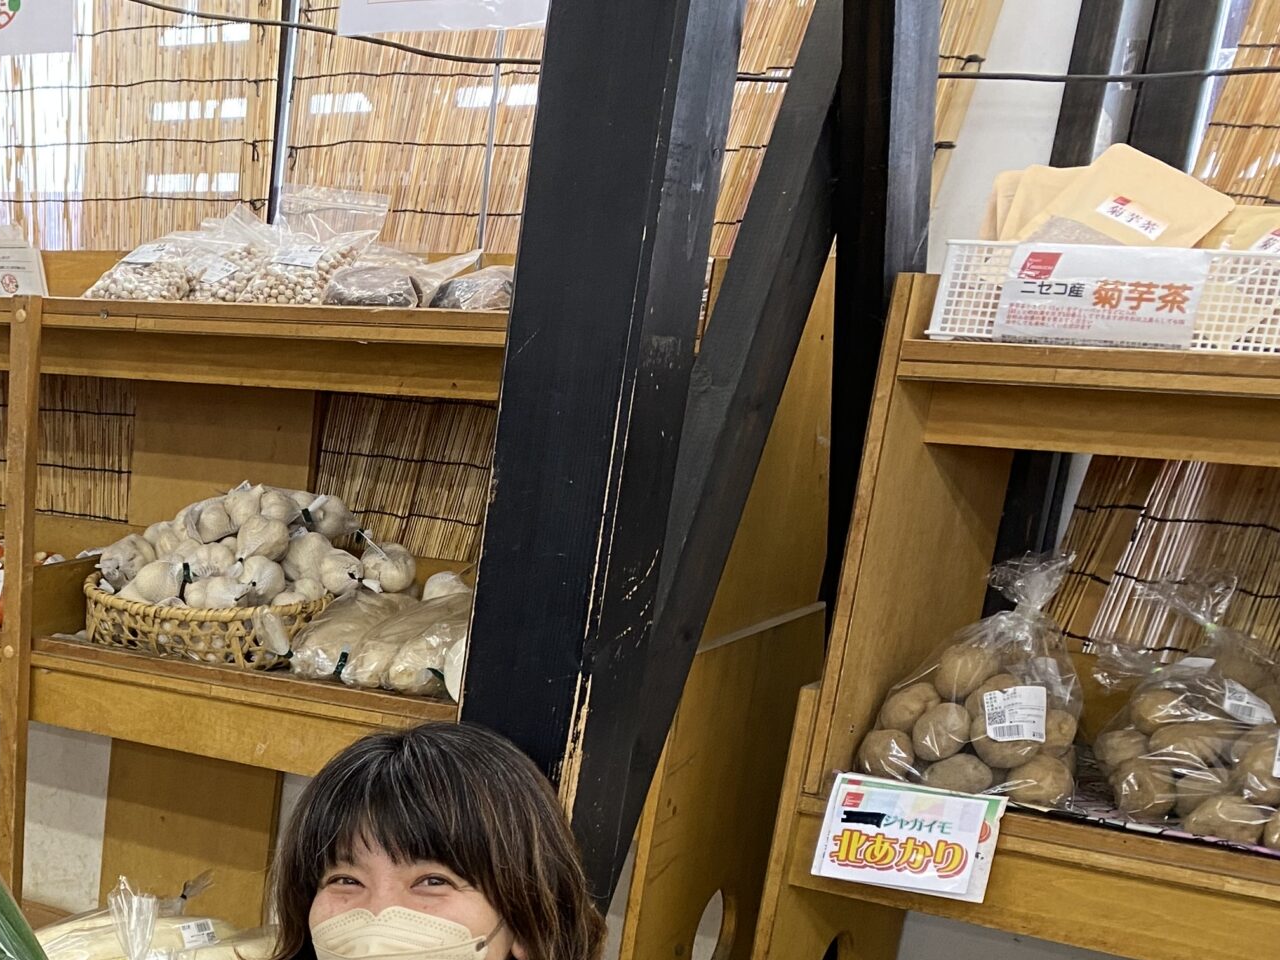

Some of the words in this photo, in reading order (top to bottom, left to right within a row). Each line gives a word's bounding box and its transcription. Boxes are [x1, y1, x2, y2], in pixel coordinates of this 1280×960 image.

[1020, 281, 1086, 298] ニセコ産
[1093, 280, 1194, 313] 菊芋茶
[829, 828, 968, 878] 北あかり
